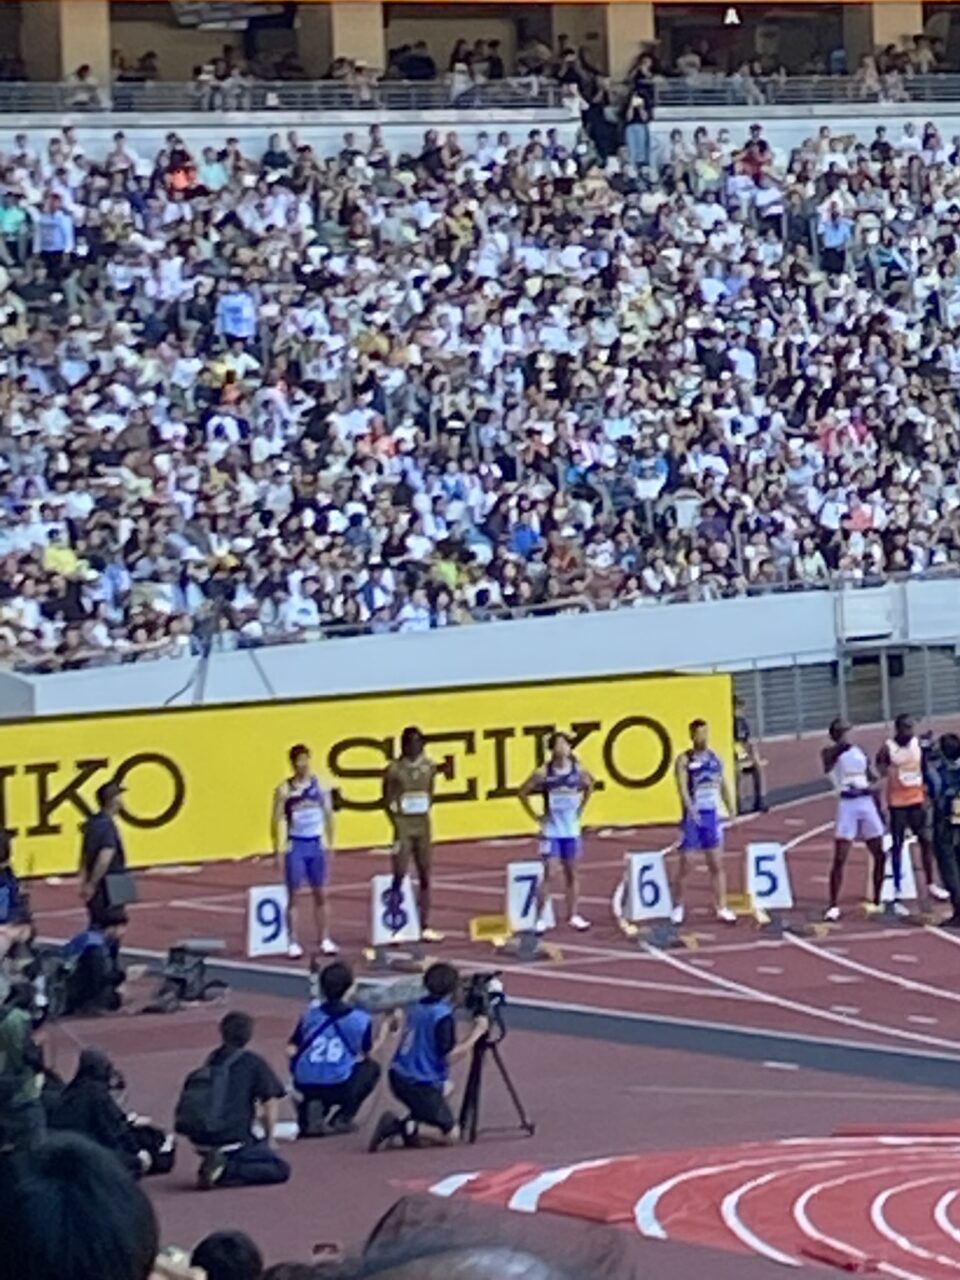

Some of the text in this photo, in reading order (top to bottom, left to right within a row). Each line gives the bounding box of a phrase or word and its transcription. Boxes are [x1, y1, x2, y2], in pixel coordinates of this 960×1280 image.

[327, 715, 673, 811] SEIKO
[513, 874, 538, 918] 7
[637, 864, 661, 908] 6
[754, 854, 779, 898] 5
[256, 898, 282, 943] 9
